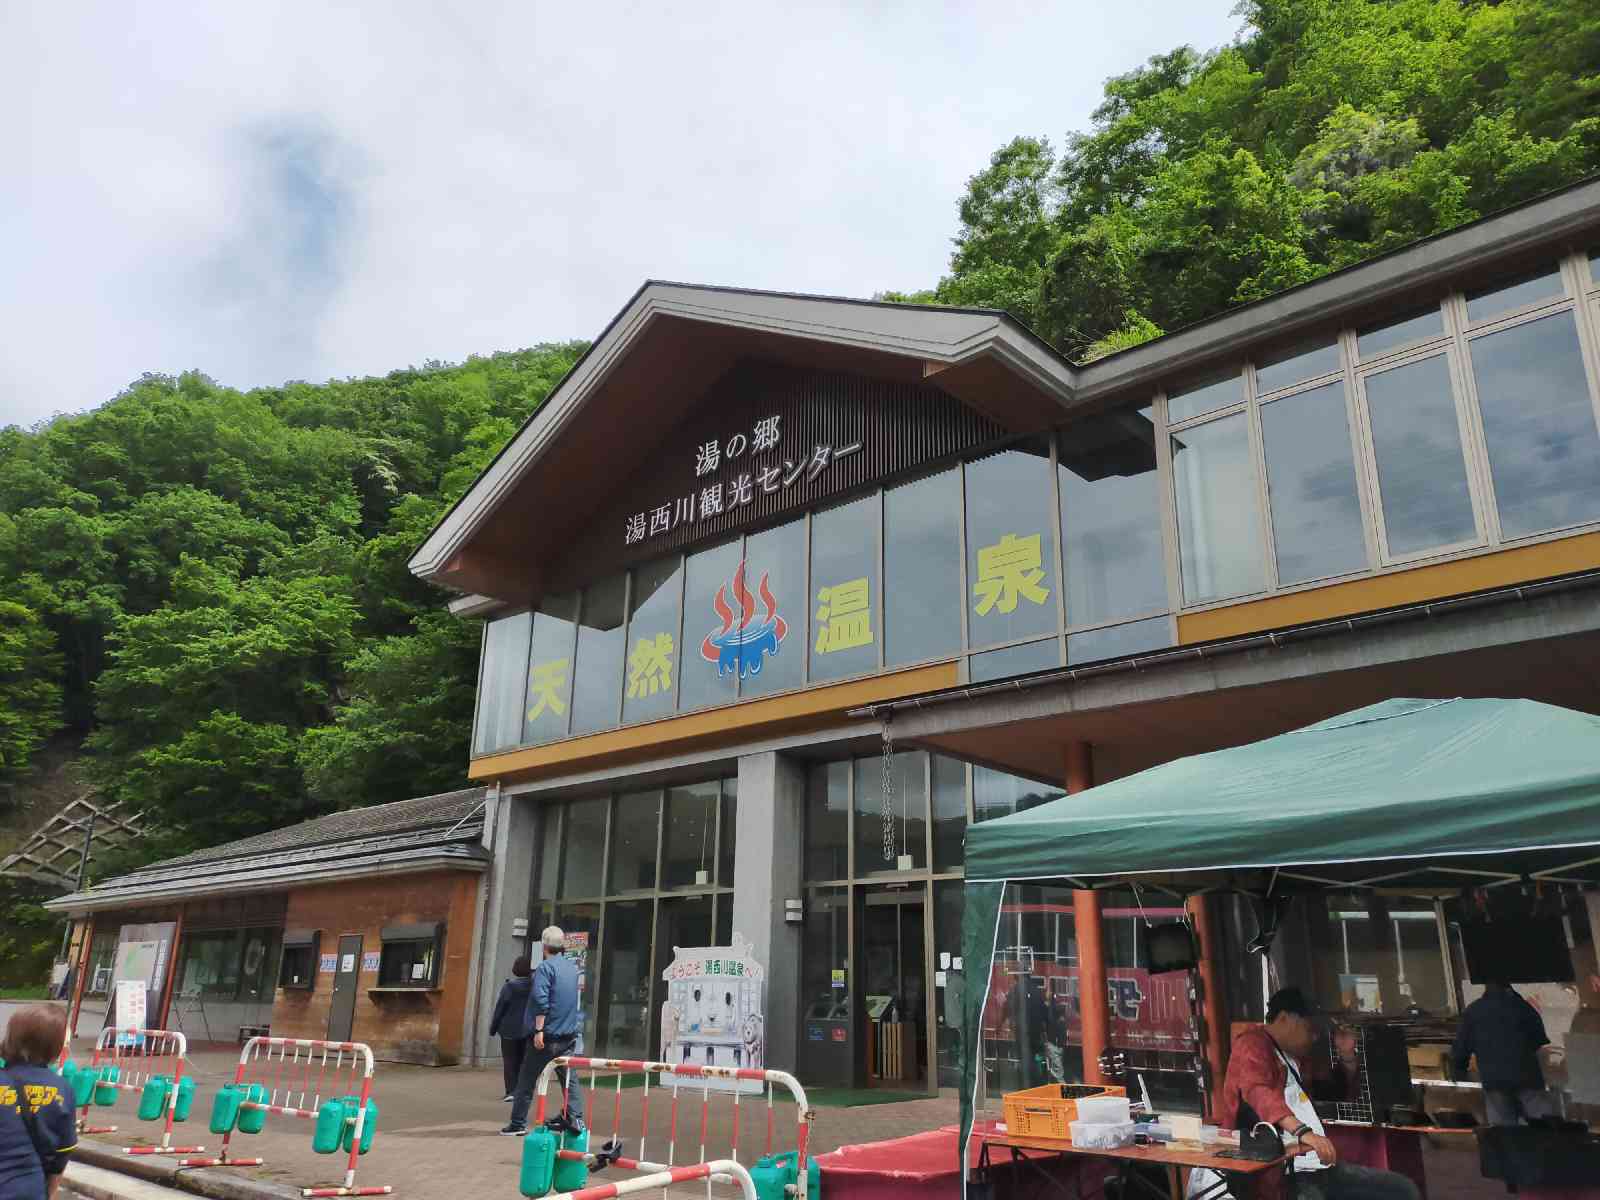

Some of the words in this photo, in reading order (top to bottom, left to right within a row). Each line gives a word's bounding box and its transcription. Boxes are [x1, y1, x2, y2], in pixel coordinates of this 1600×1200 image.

[695, 415, 782, 477] 湯の郷
[624, 440, 864, 545] 湯西川観光センター
